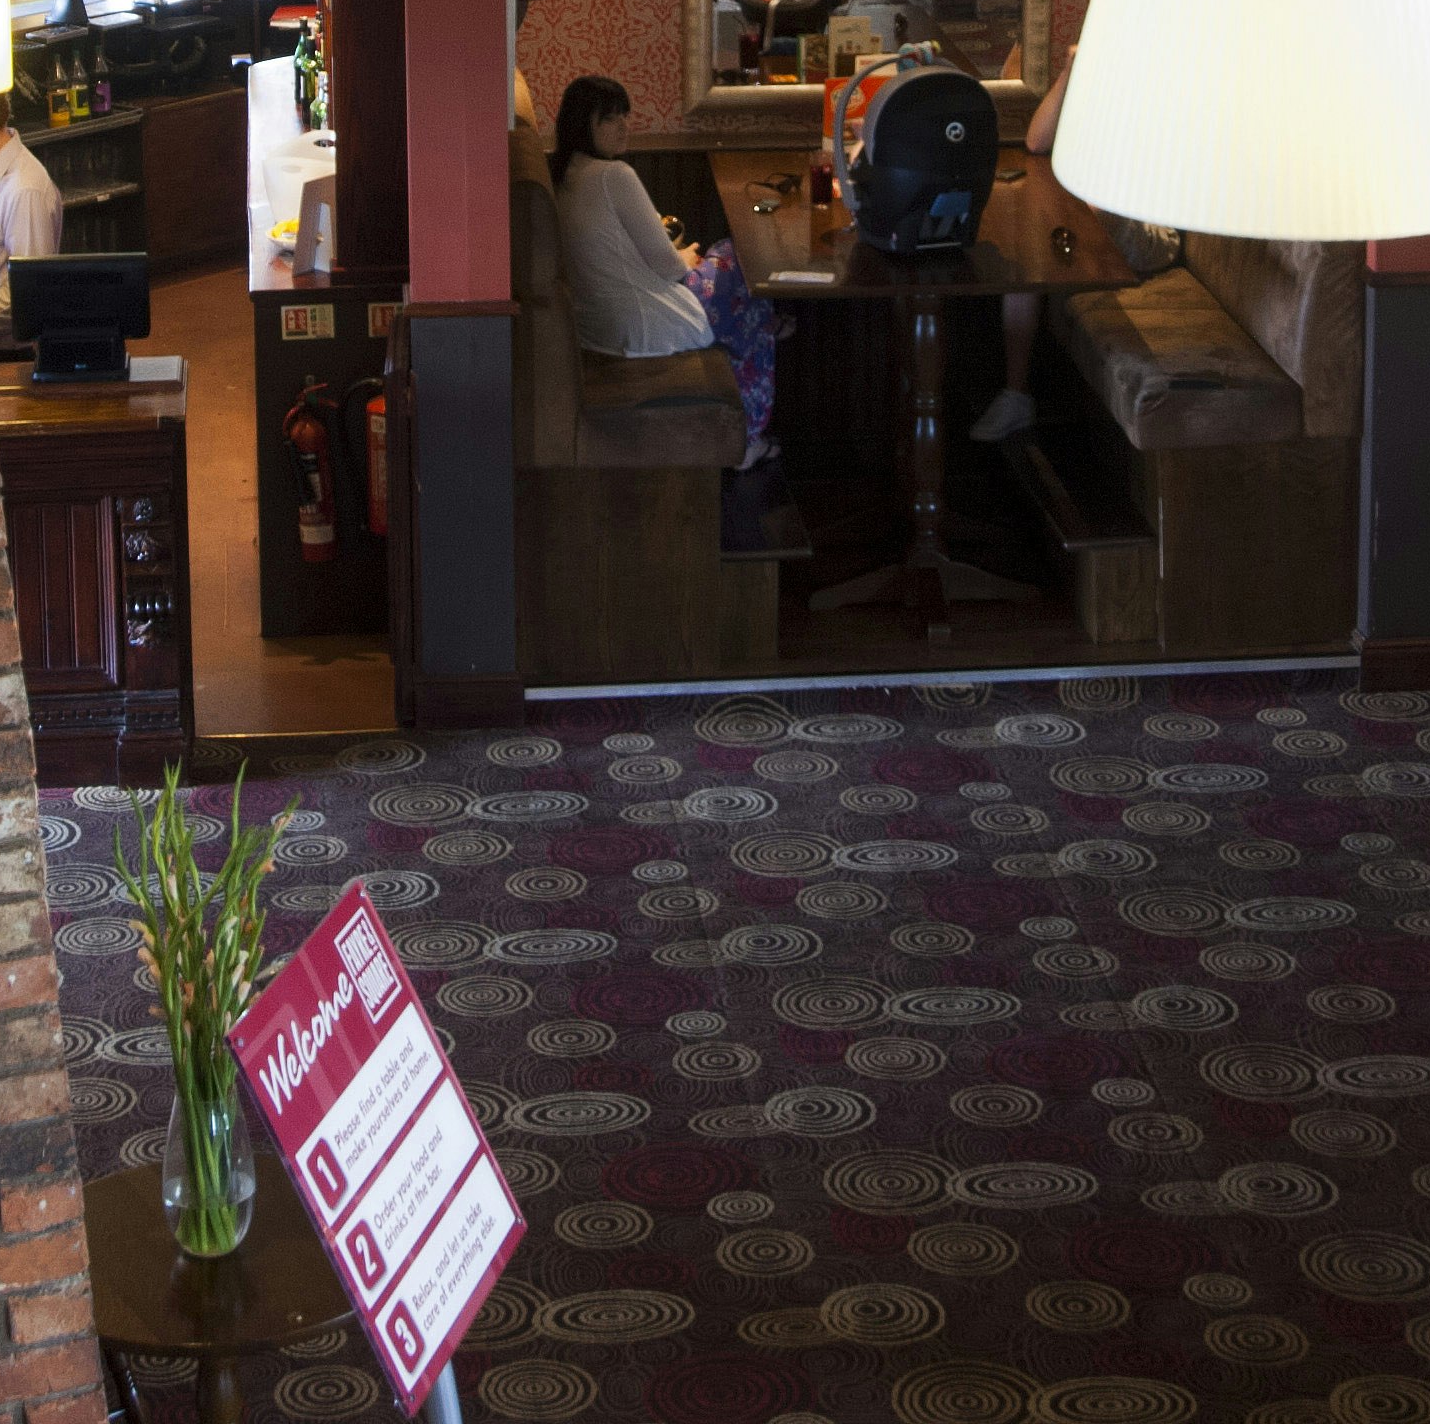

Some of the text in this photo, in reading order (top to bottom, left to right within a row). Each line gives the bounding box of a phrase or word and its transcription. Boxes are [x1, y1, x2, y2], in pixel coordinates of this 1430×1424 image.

[341, 924, 374, 976] FAYRE
[357, 951, 394, 1009] SQUARE
[259, 972, 353, 1114] Welcome
[334, 1037, 414, 1150] Please find a table and
[345, 1051, 431, 1170] make yourselves at home.
[317, 1155, 338, 1190] 1
[373, 1126, 443, 1229] Order your food and
[384, 1164, 442, 1251] drinks at the bar.
[355, 1234, 377, 1276] 2
[411, 1203, 482, 1312] Relax, and let us take
[423, 1303, 440, 1331] care
[447, 1236, 483, 1293] everything
[394, 1317, 416, 1356] 3
